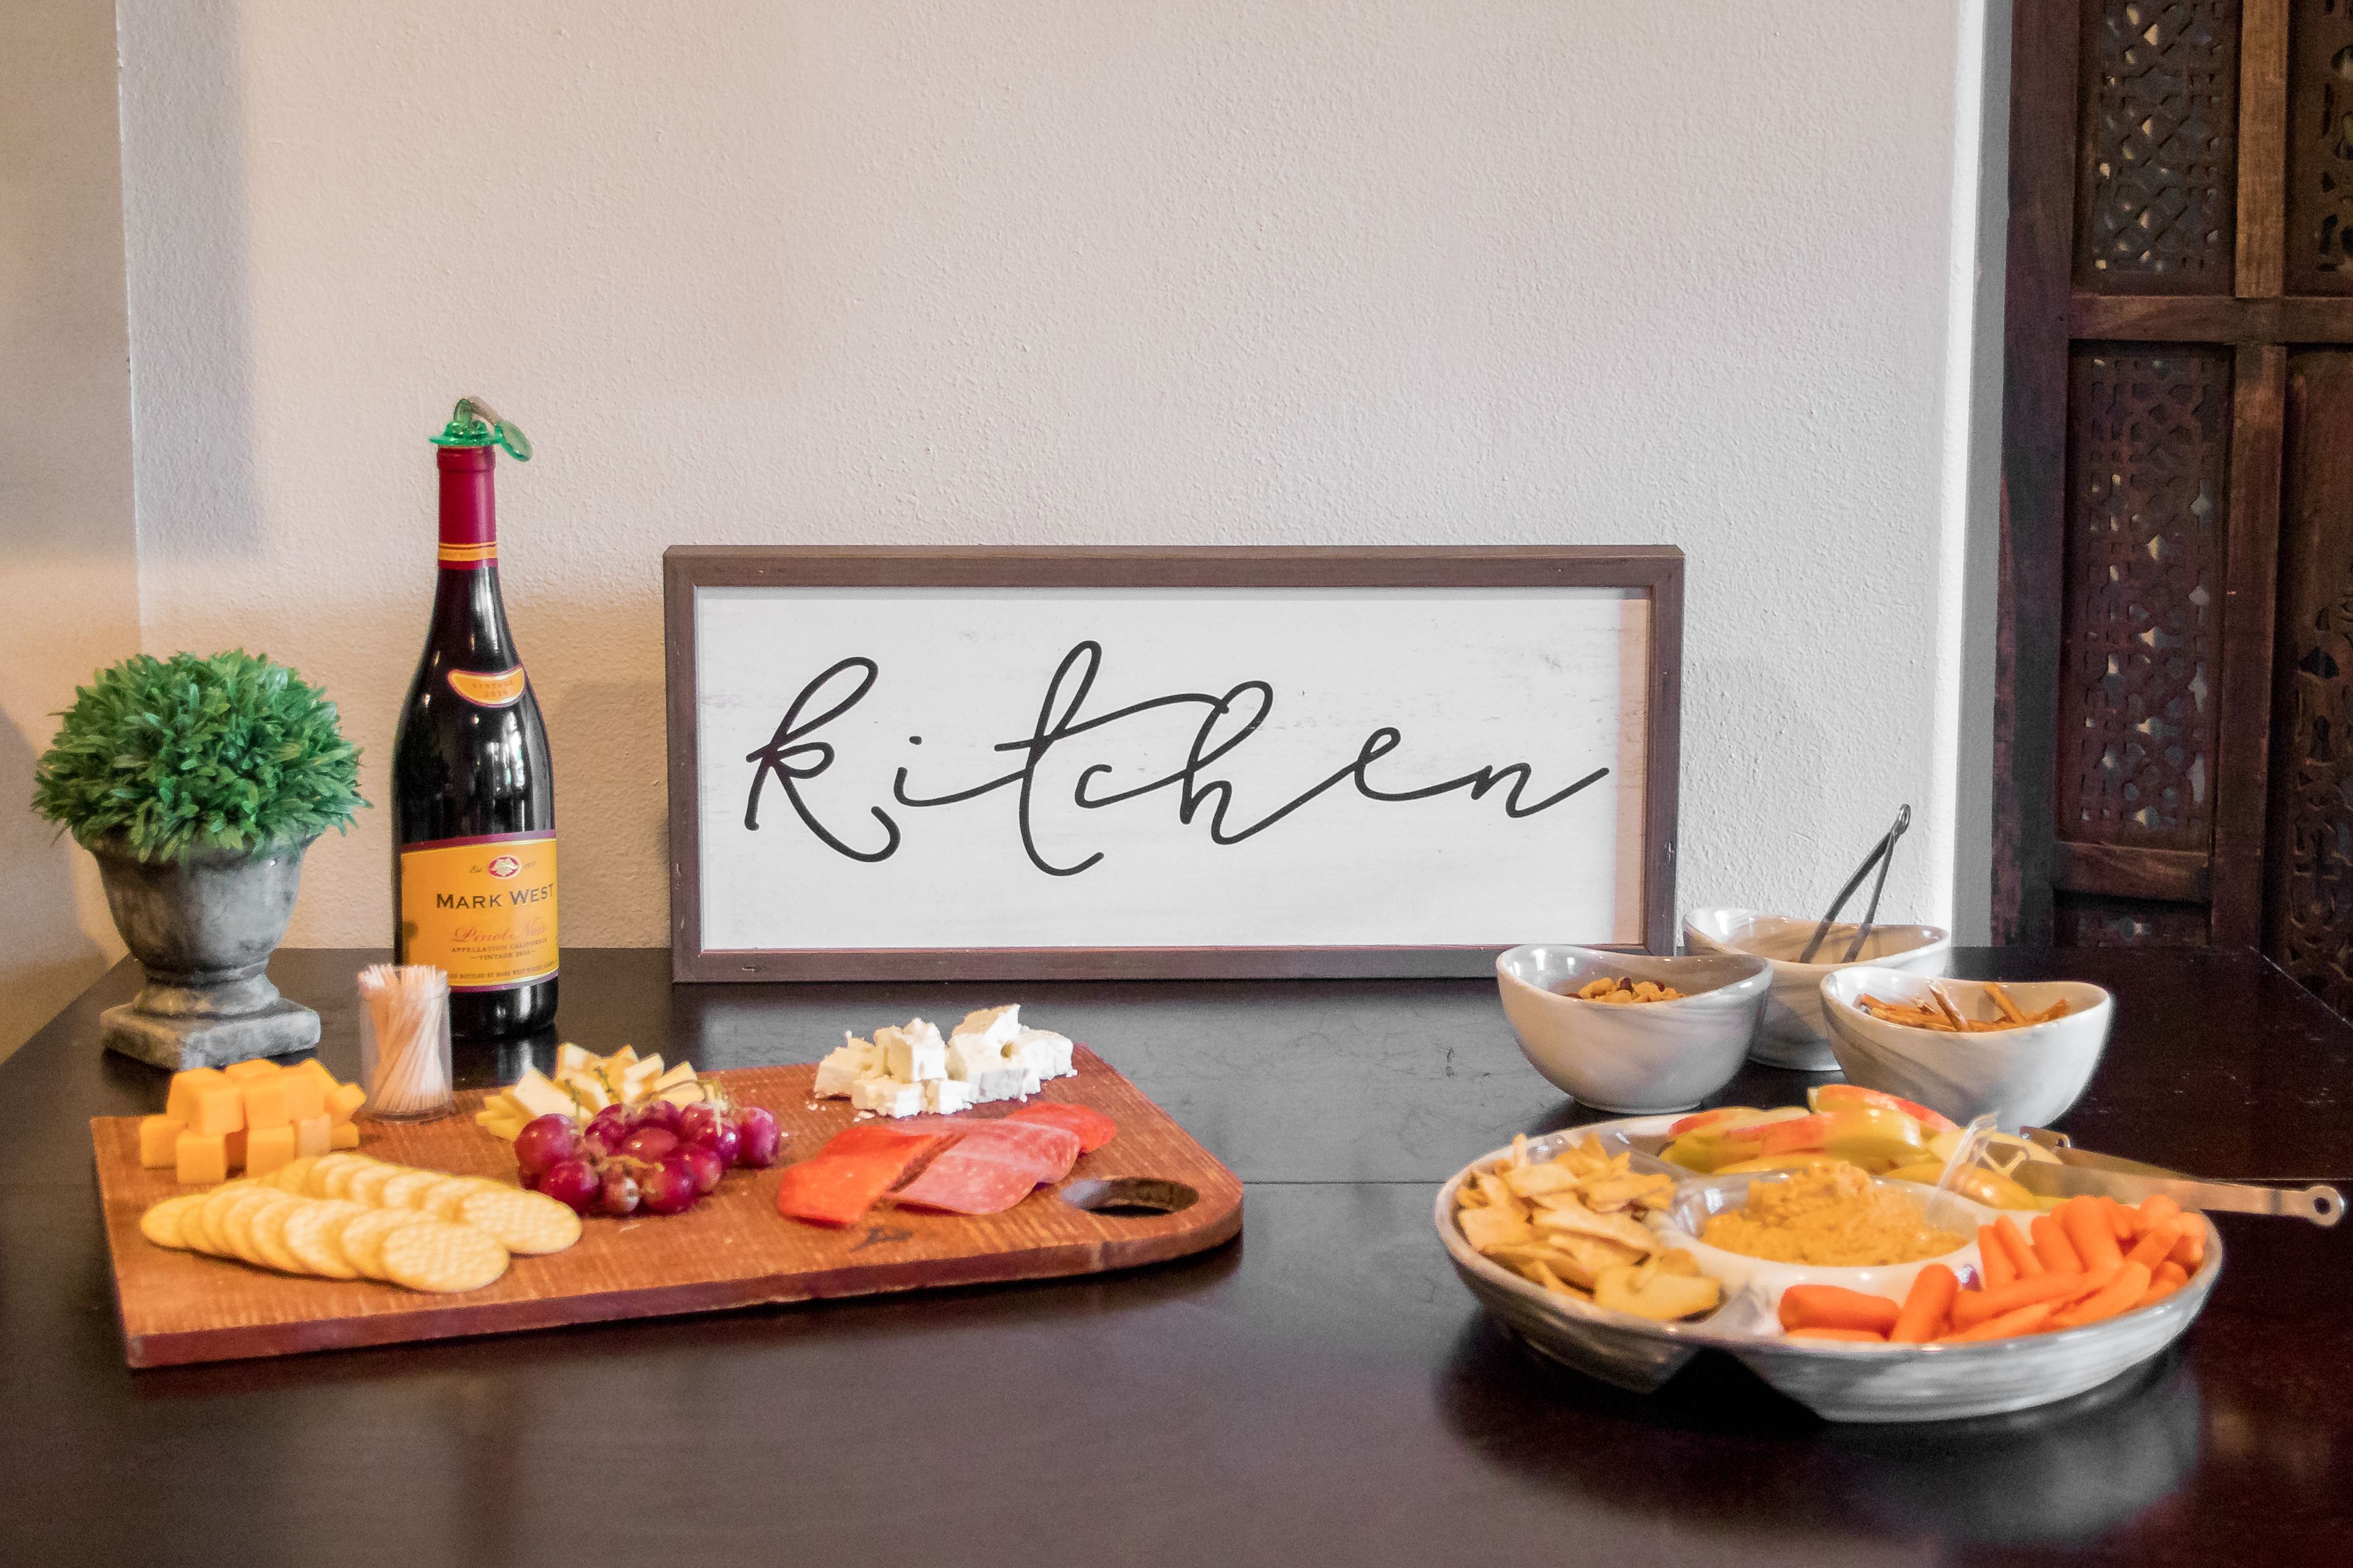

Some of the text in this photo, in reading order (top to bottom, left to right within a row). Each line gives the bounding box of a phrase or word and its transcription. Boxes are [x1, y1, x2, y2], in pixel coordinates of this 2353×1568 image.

[471, 680, 514, 689] VINTAGE
[745, 641, 1608, 876] kitchen
[436, 883, 554, 909] MARK WEST
[451, 917, 546, 943] Pinot Noir
[451, 937, 548, 953] APPELLATION CALIFORNIA
[479, 952, 515, 961] VINTAGE
